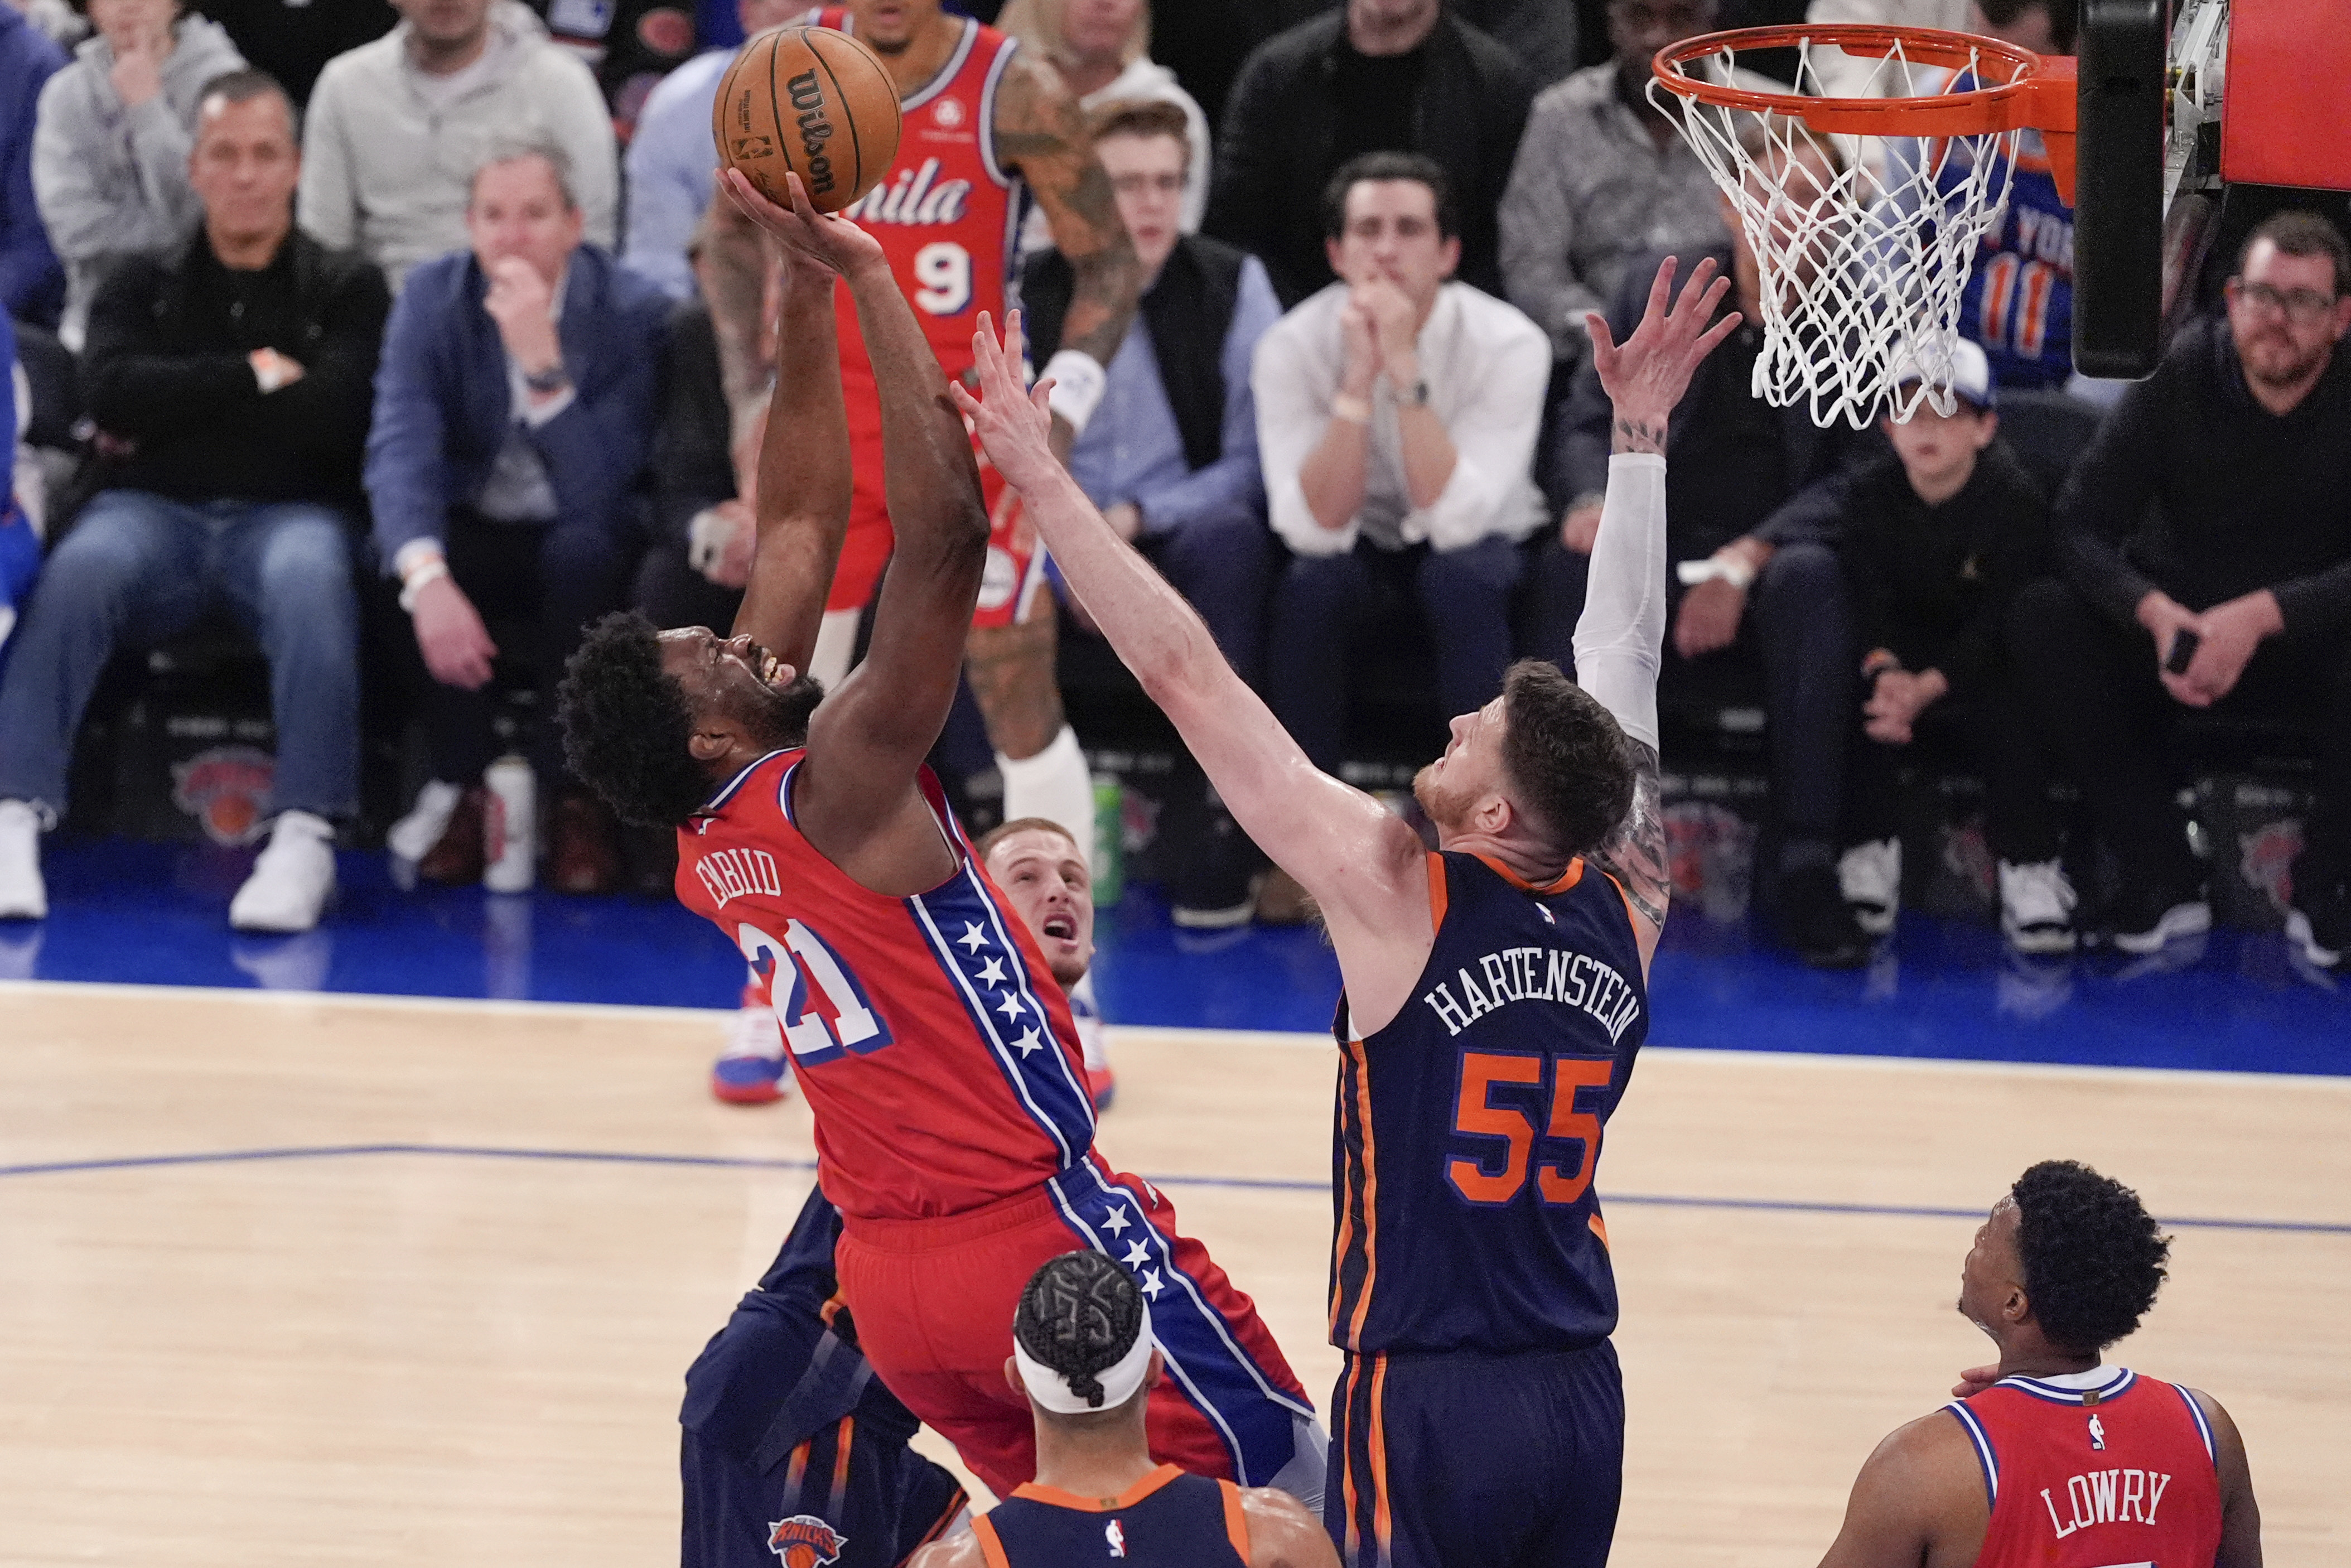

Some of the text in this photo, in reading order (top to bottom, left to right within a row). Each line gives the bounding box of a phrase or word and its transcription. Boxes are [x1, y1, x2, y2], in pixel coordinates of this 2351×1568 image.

[786, 67, 836, 195] Wilson
[844, 157, 971, 226] hila
[914, 240, 973, 317] 9
[1981, 251, 2056, 360] 11
[737, 918, 887, 1061] 21
[1423, 947, 1640, 1046] HARTENSTEIN
[1446, 1049, 1616, 1205] 55
[771, 1521, 837, 1557] KNICKS
[2040, 1468, 2171, 1540] LOWRY
